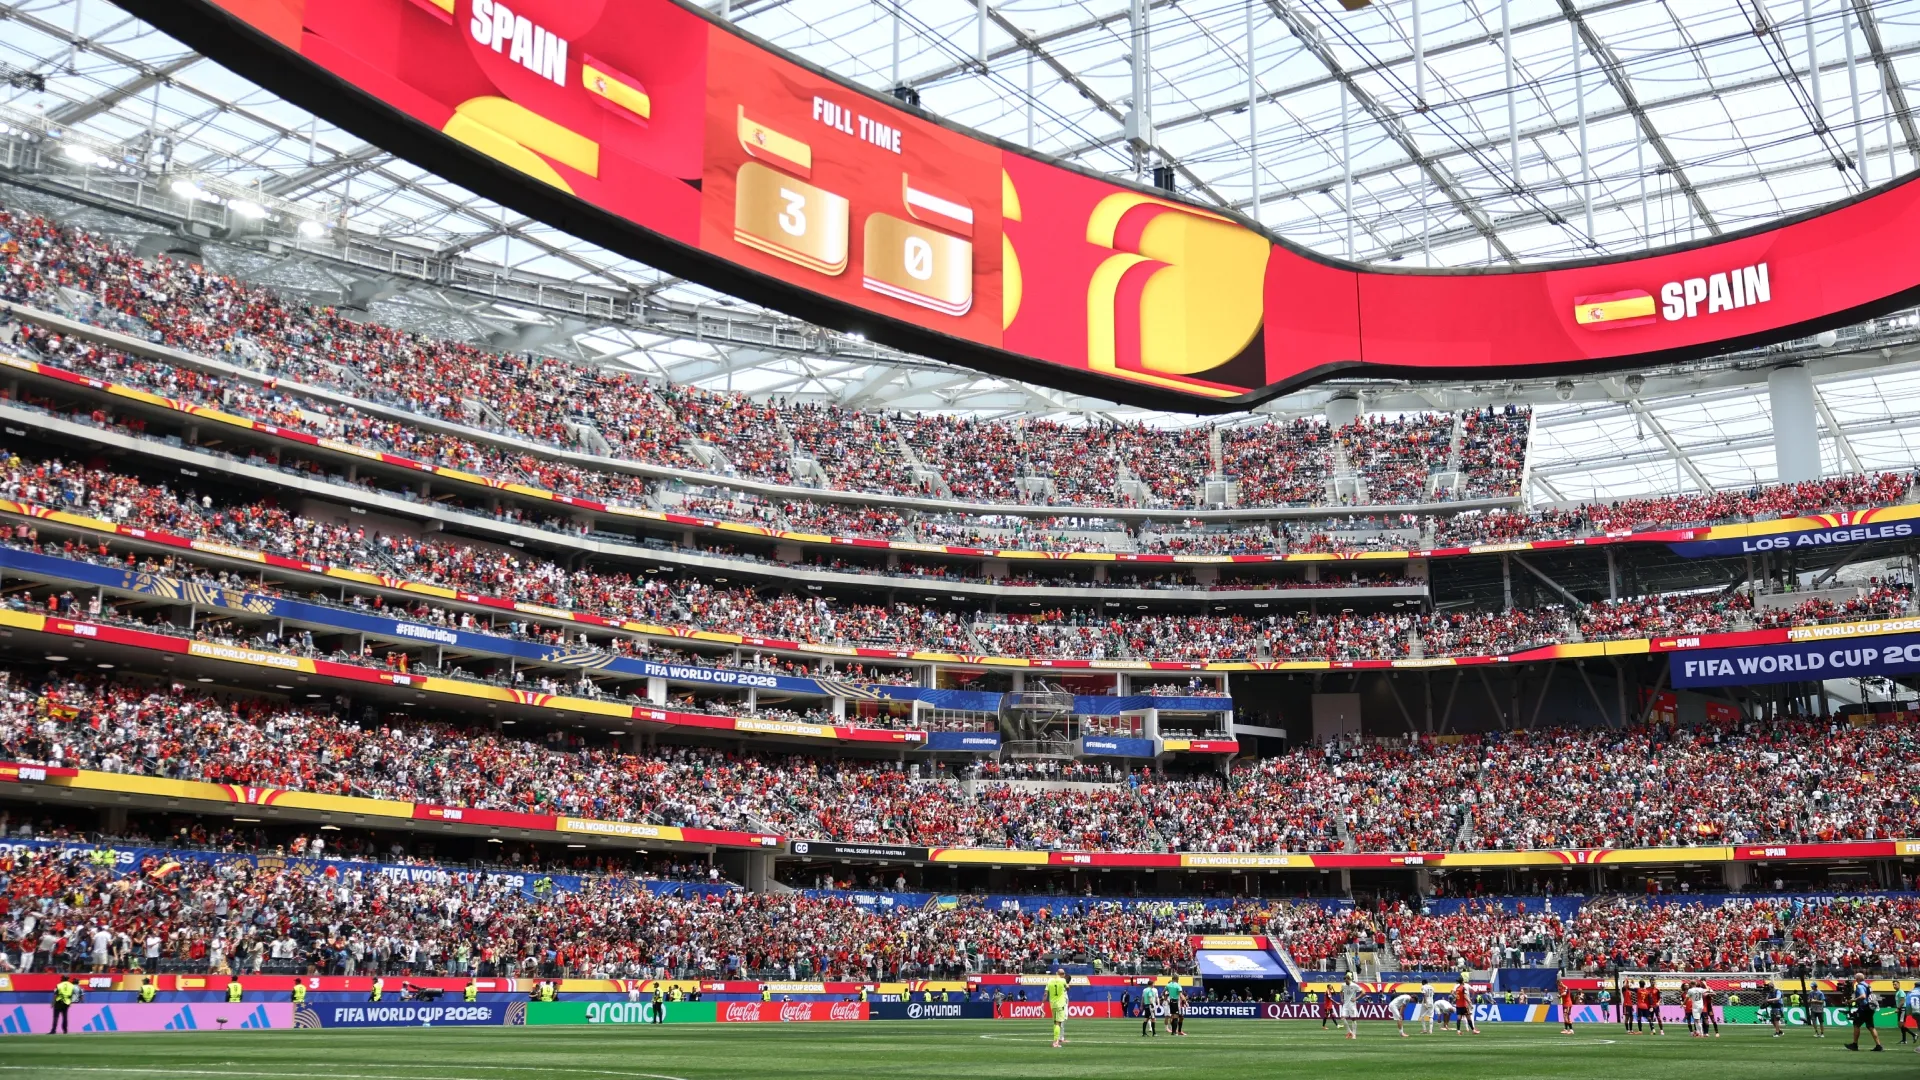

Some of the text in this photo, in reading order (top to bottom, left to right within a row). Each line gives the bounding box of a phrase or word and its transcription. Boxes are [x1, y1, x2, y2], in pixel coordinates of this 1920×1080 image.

[470, 0, 568, 87] SPAIN
[812, 96, 902, 154] FULL TIME
[778, 188, 806, 236] 3
[905, 235, 933, 280] 0
[1661, 262, 1771, 322] SPAIN
[1743, 524, 1912, 552] LOS ANGELES
[396, 624, 457, 645] #FIFAWorldCup
[1787, 630, 1812, 639] FIFA
[1813, 626, 1856, 637] WORLD
[1857, 623, 1880, 633] CUP
[1677, 637, 1700, 647] SPAIN
[192, 644, 298, 668] FIFA WORLD CUP 2026
[1685, 659, 1735, 677] FIFA
[1737, 652, 1824, 674] WORLD
[1829, 648, 1878, 667] CUP
[646, 664, 776, 687] FIFA WORLD CUP 2026
[797, 726, 822, 734] 2026
[19, 767, 46, 780] SPAIN
[568, 820, 658, 835] FIFA WORLD CUP 2026
[1074, 855, 1090, 863] SPAIN
[1765, 848, 1786, 856] SPAIN
[89, 977, 112, 987] SPAIN
[310, 978, 319, 988] 3
[1054, 985, 1058, 996] 1
[335, 1008, 365, 1022] FIFA
[367, 1008, 415, 1021] WORLD
[418, 1007, 443, 1021] CUP
[924, 1005, 961, 1016] HYUNDAI
[1268, 1004, 1320, 1018] QATAR
